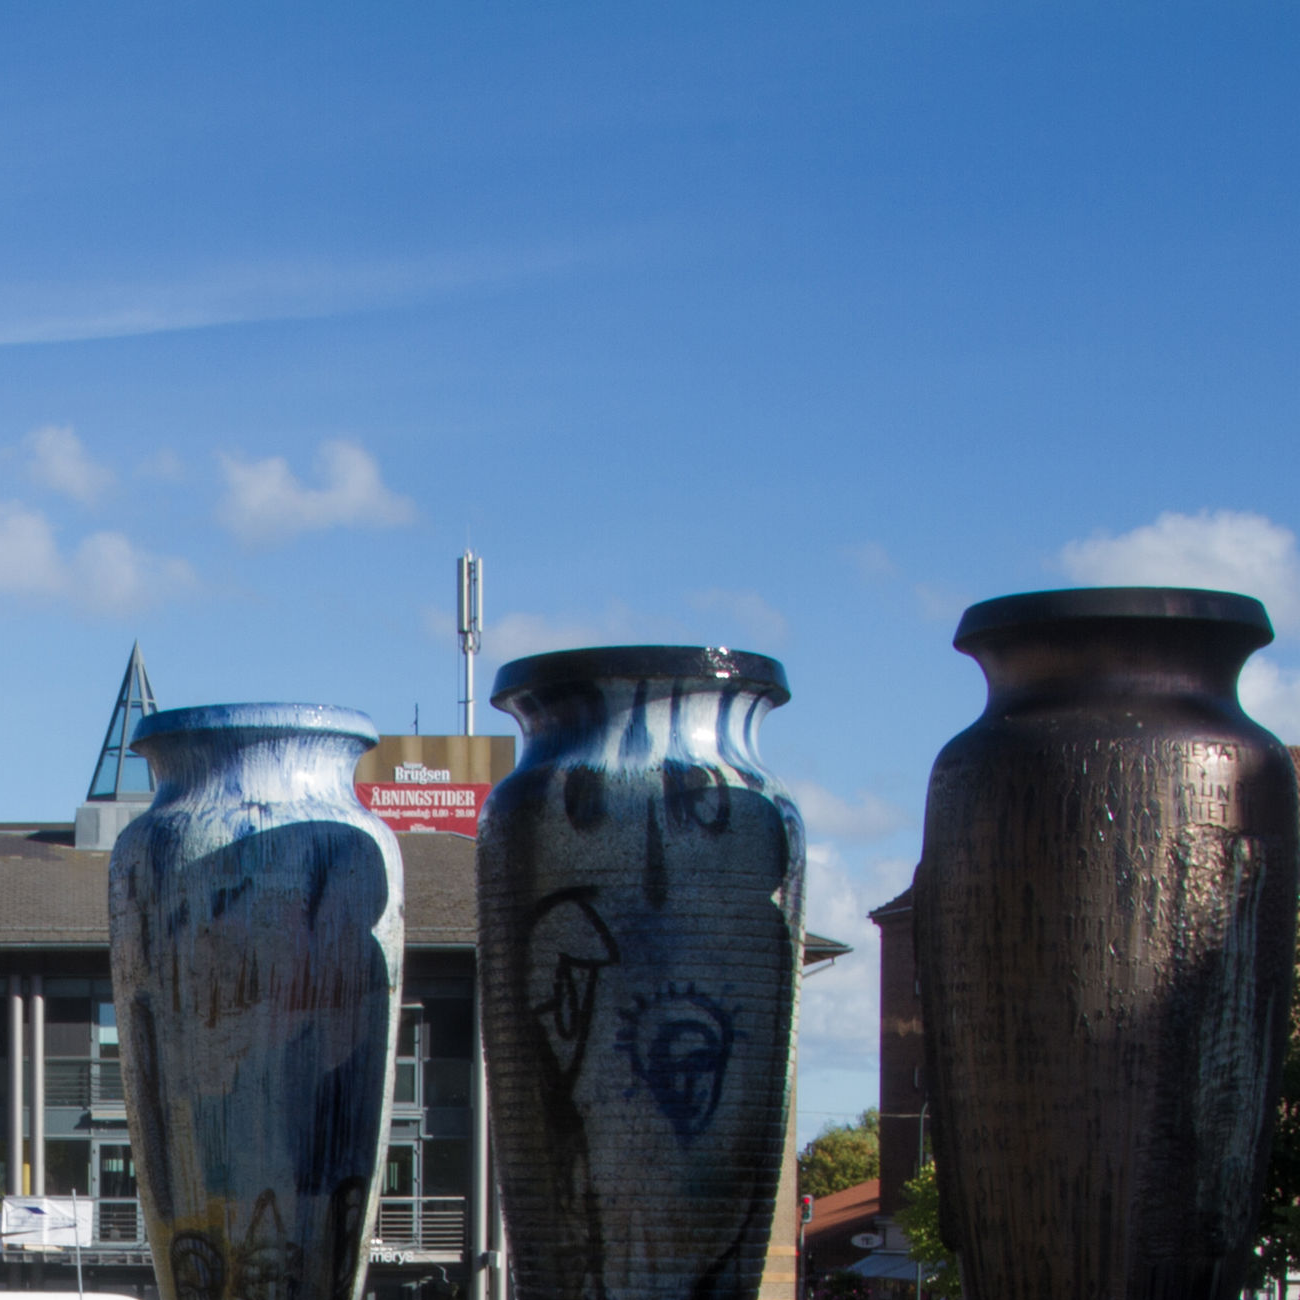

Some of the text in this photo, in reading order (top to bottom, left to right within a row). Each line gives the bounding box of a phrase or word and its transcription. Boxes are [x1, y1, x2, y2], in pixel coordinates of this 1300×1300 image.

[394, 767, 450, 784] Brugsen
[371, 787, 475, 806] ÅBNINGSTIDER
[370, 1250, 414, 1265] merys
